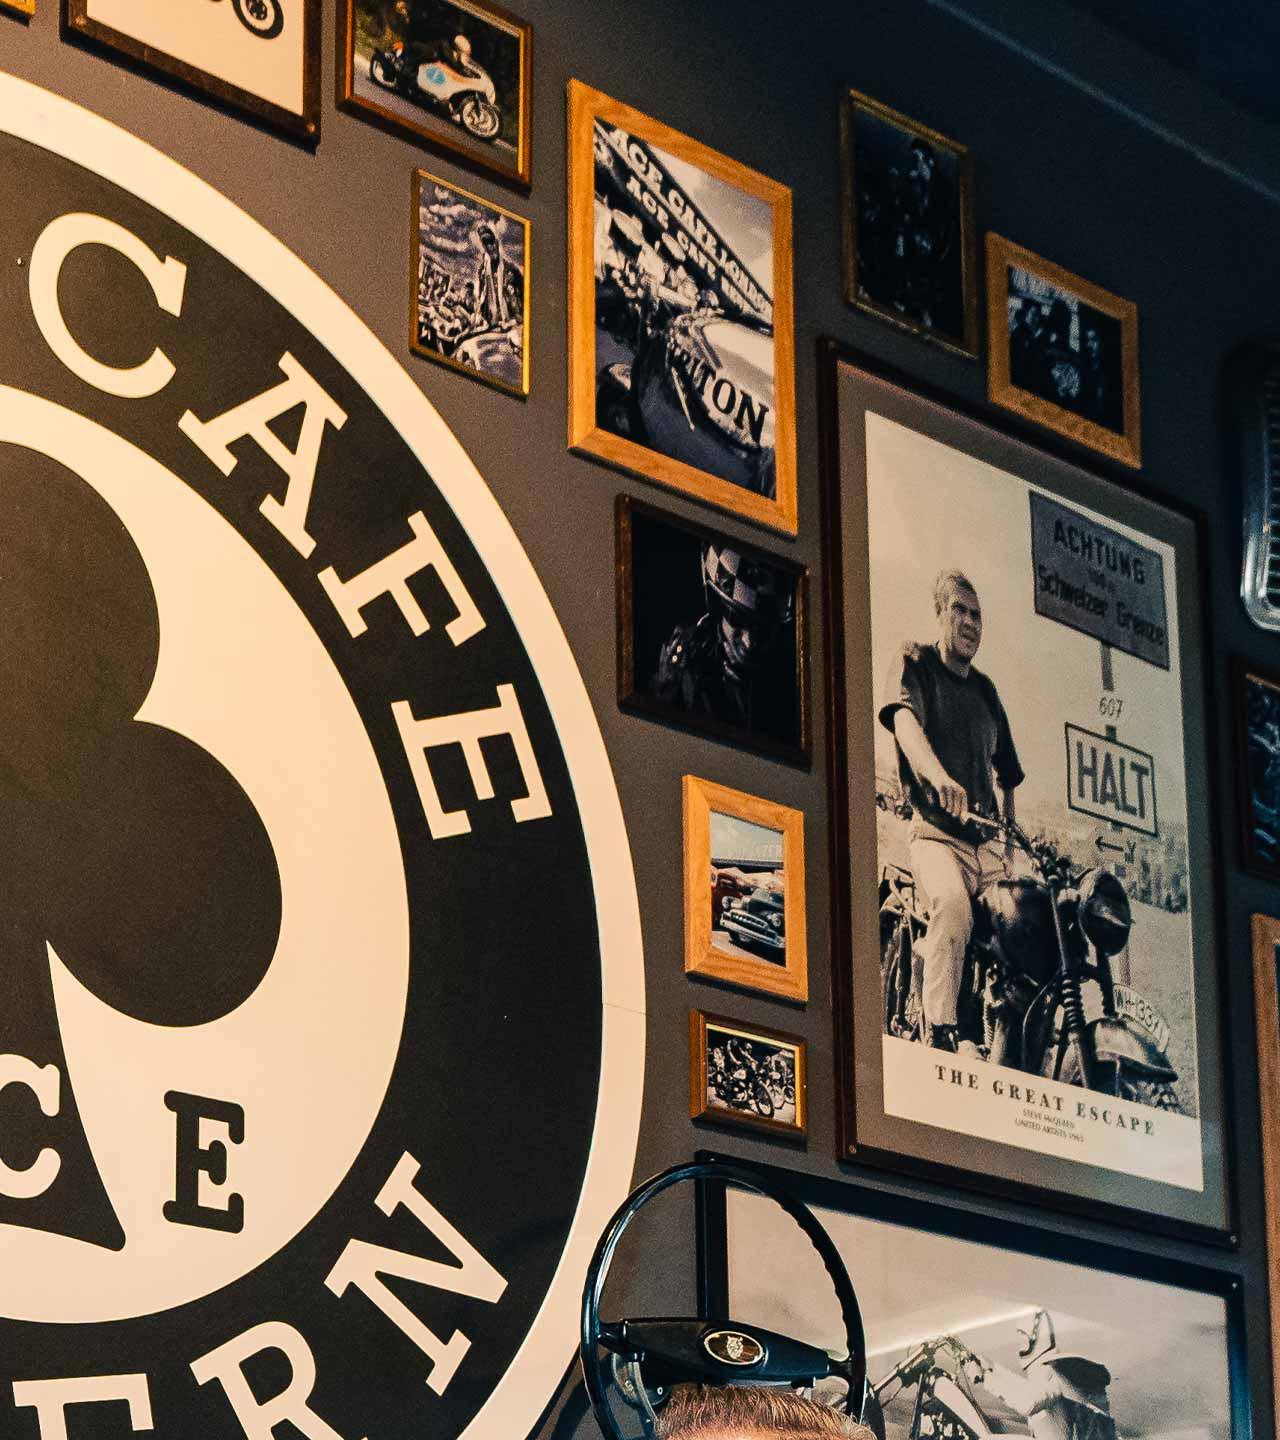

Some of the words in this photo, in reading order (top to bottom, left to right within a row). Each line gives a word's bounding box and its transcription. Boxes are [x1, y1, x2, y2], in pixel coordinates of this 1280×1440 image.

[29, 212, 552, 839] CAFE
[1054, 519, 1145, 585] ACHTUNG
[1099, 696, 1123, 719] 607
[1076, 740, 1150, 819] HALT
[935, 1064, 980, 1090] THE
[992, 1079, 1065, 1112] GREAT
[1076, 1101, 1155, 1137] ESCAPE
